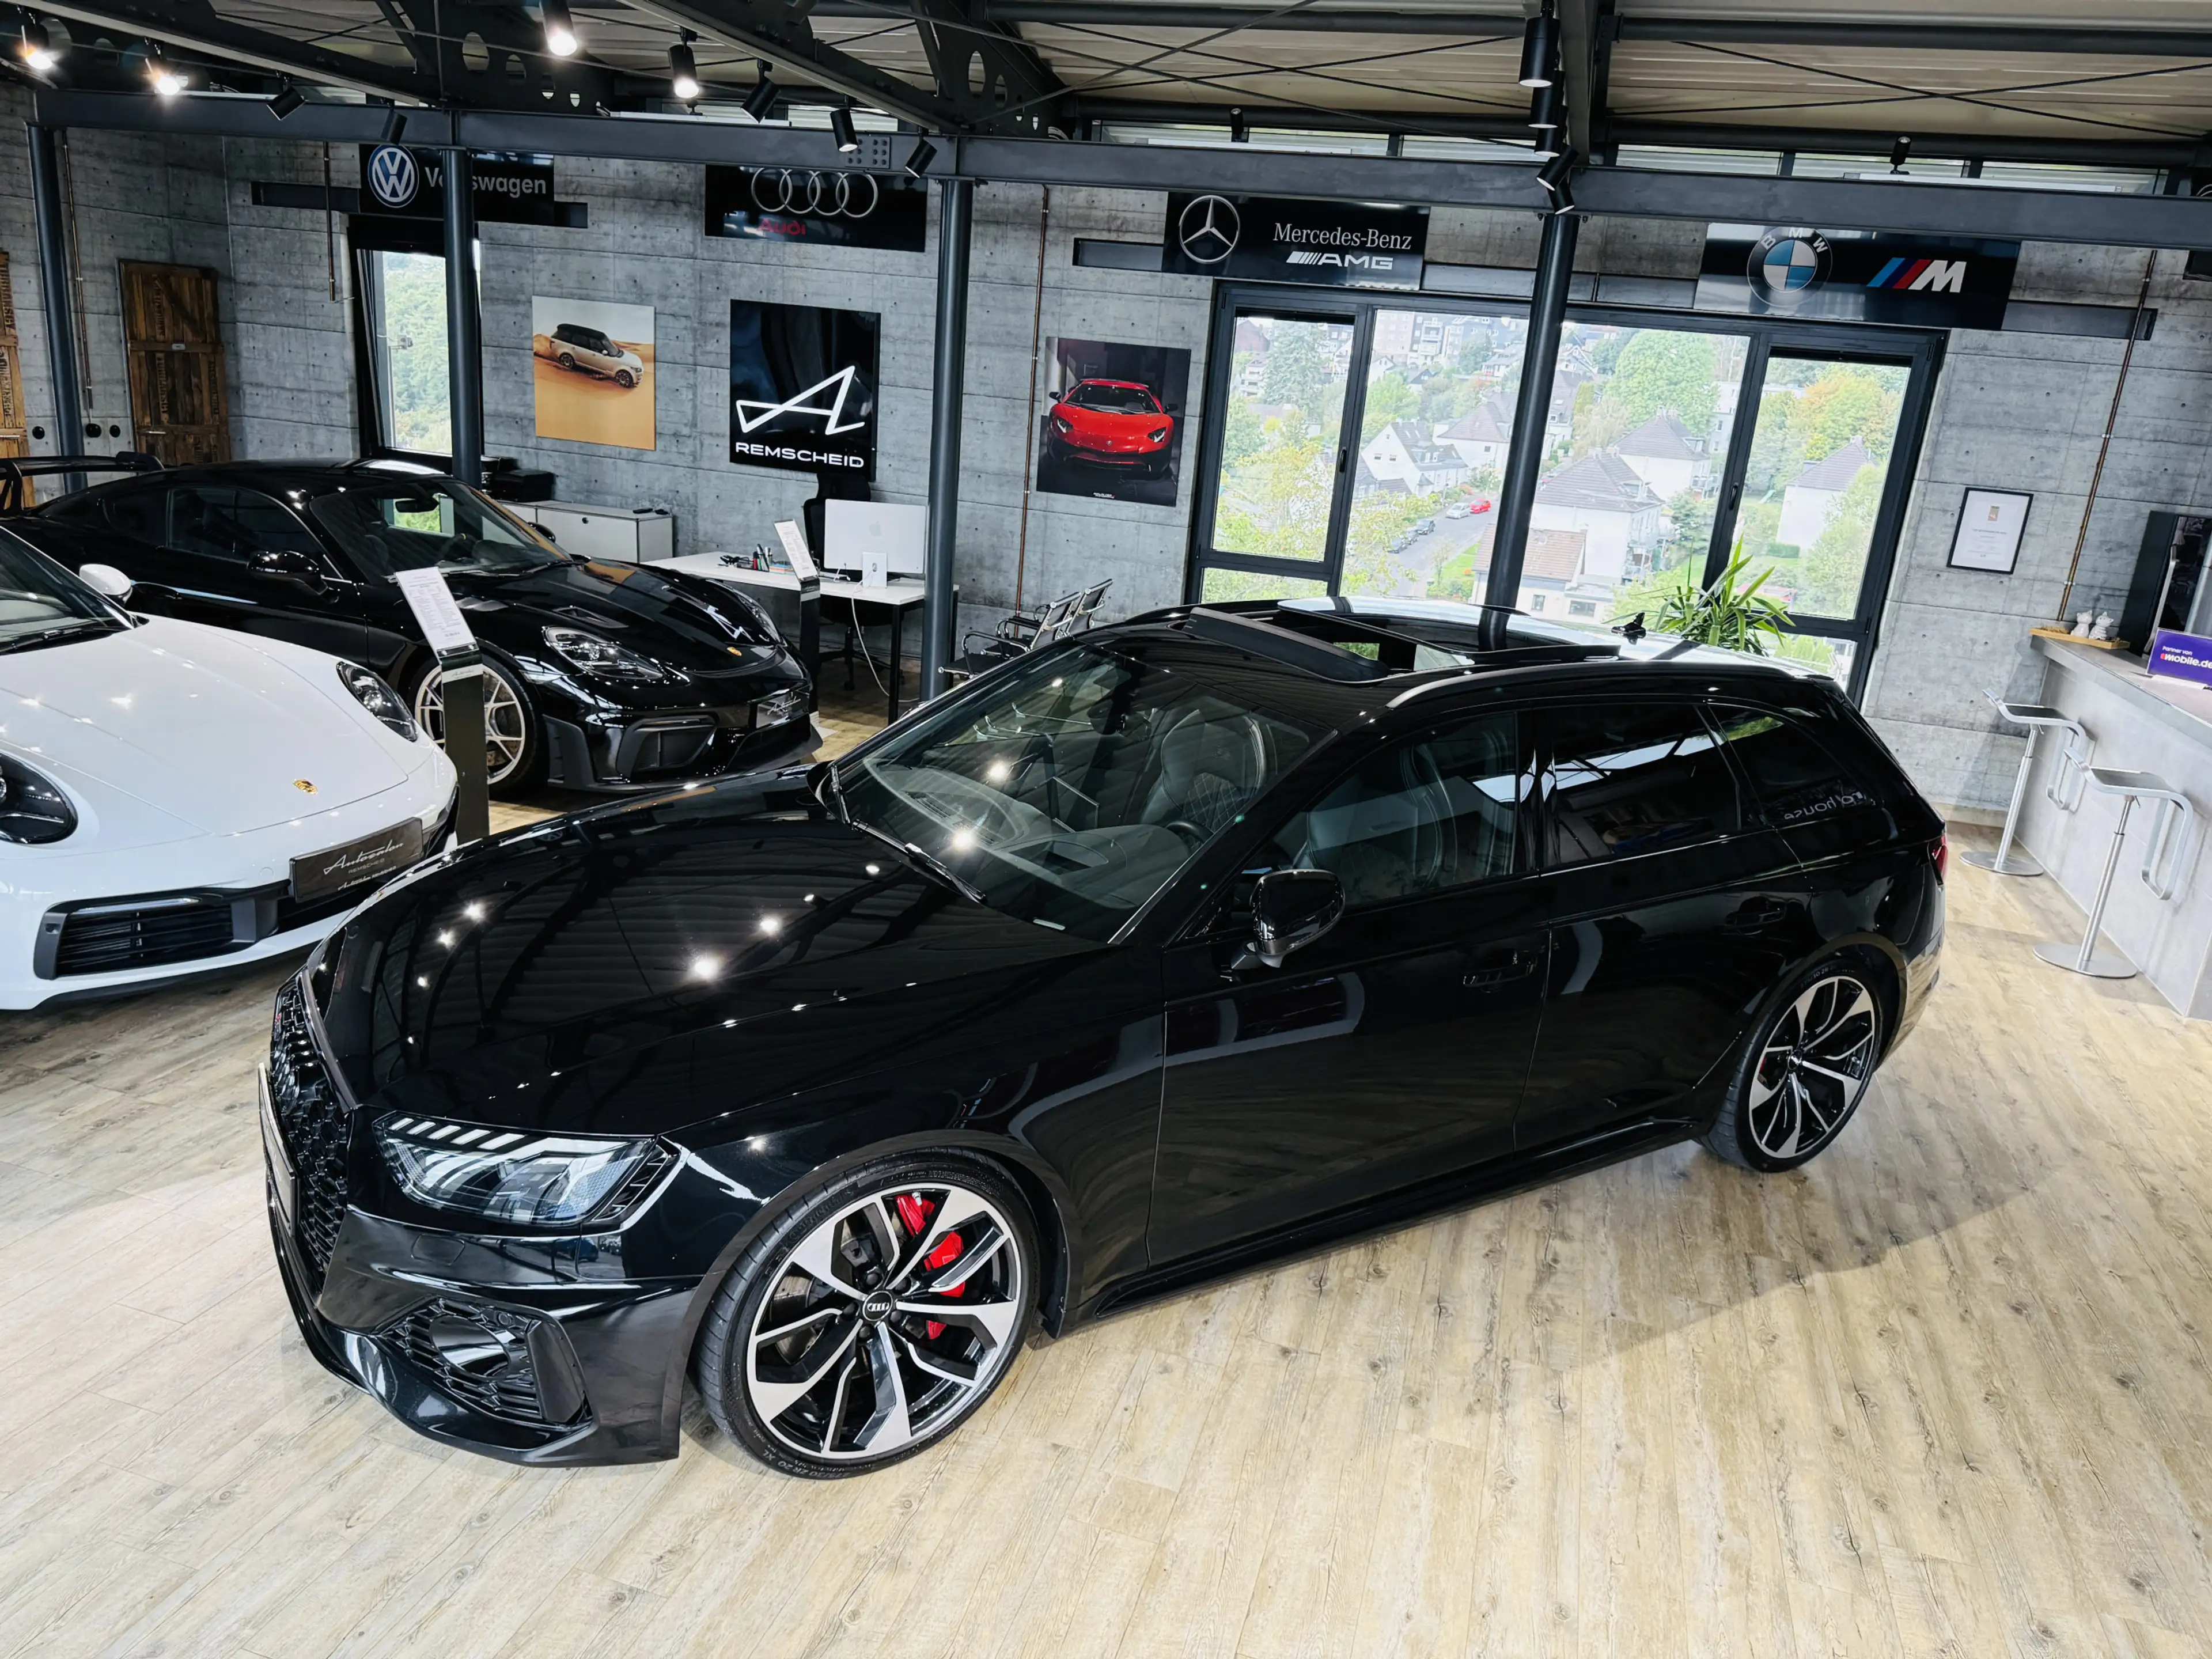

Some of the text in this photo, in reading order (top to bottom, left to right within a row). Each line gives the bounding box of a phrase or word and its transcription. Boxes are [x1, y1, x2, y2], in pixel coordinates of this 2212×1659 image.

[757, 218, 806, 236] Audi
[1272, 222, 1412, 250] Mercedes-Benz
[1760, 228, 1828, 253] BMW
[1317, 253, 1393, 270] AMG
[735, 442, 865, 468] REMSCHEID
[2164, 654, 2212, 668] mobile.de
